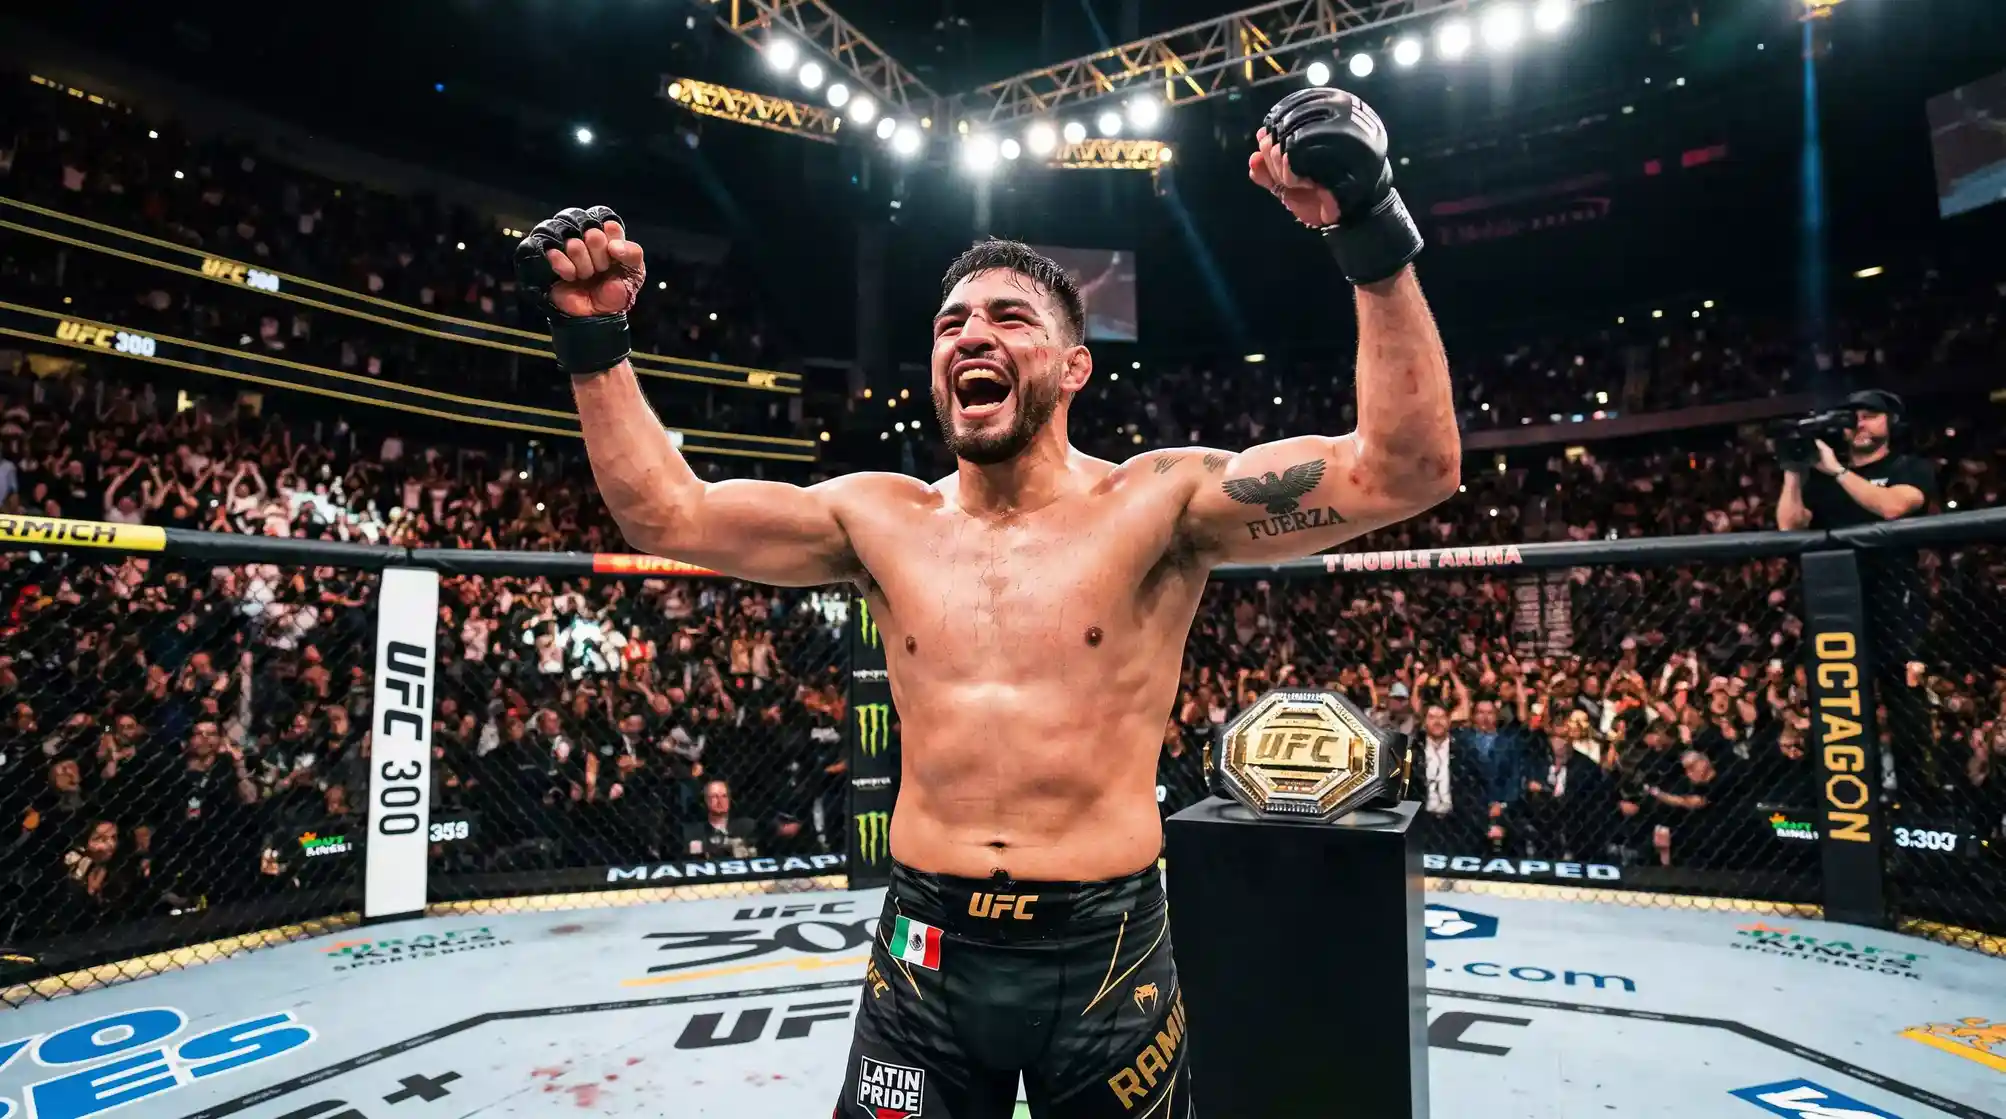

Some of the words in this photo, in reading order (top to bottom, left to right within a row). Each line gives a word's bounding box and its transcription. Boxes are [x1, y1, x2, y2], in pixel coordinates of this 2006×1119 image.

[202, 257, 247, 282] UFC
[56, 321, 115, 348] UFC
[115, 332, 156, 357] 300
[1245, 505, 1347, 540] FUERZA
[383, 641, 427, 741] UFC
[1255, 732, 1339, 764] UFC
[1815, 631, 1871, 843] OCTAGON
[379, 760, 422, 836] 300
[606, 854, 847, 882] MANSCAP
[733, 901, 856, 921] UFC
[968, 892, 1039, 920] UFC
[862, 1060, 920, 1091] LATIN
[860, 1080, 919, 1111] PRIDE
